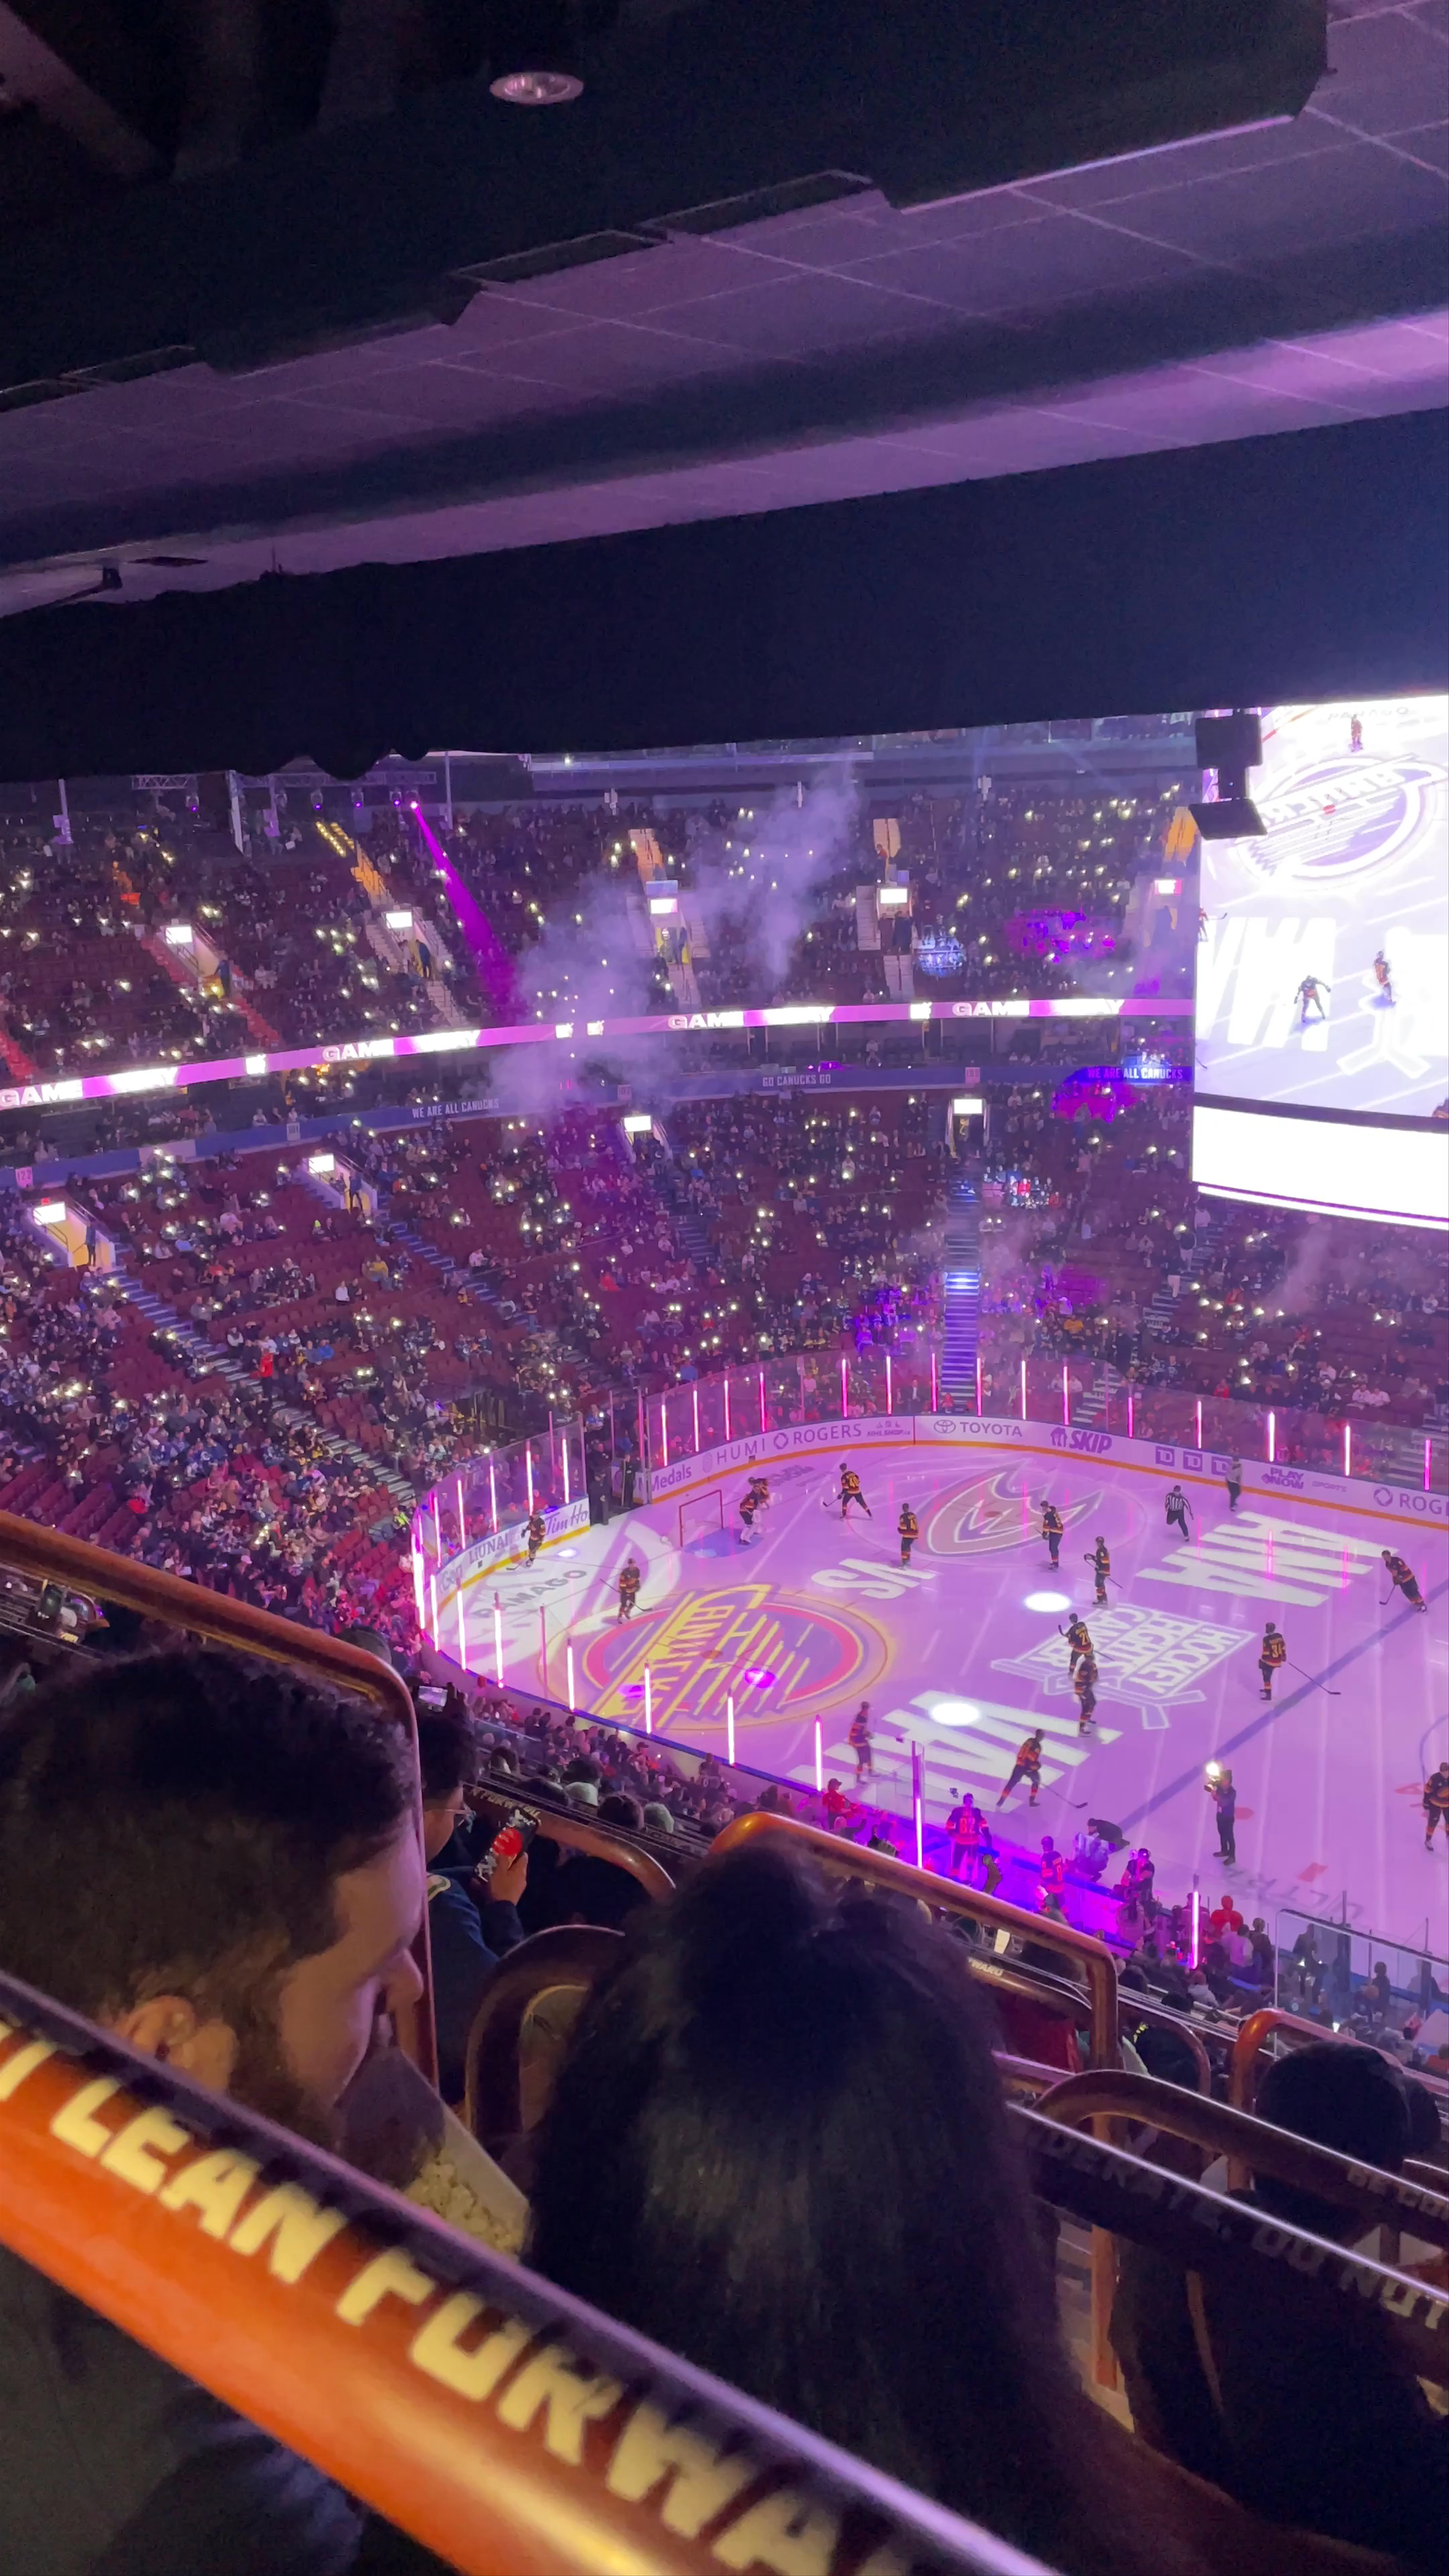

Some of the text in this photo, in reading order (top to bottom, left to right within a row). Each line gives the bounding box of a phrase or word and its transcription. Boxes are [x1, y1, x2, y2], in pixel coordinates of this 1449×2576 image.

[762, 1073, 831, 1087] GO CANUCKS GO
[1088, 1068, 1183, 1079] WE ARE ALL CANUCKS
[412, 1098, 500, 1118] WE ARE ALL CANUCKS
[794, 1423, 862, 1445] ROGERS
[960, 1421, 1023, 1437] TOYOTA
[717, 1438, 766, 1466] HUMI
[1069, 1430, 1112, 1454] SKIP
[1270, 1467, 1304, 1481] PLAY
[1273, 1476, 1304, 1490] NOW
[1400, 1493, 1449, 1516] ROG
[545, 1503, 589, 1536] Tim Ho
[811, 1558, 936, 1599] VS
[1129, 1626, 1242, 1694] HOCKEY
[52, 2078, 349, 2285] LEAN
[1339, 2267, 1449, 2330] NOT
